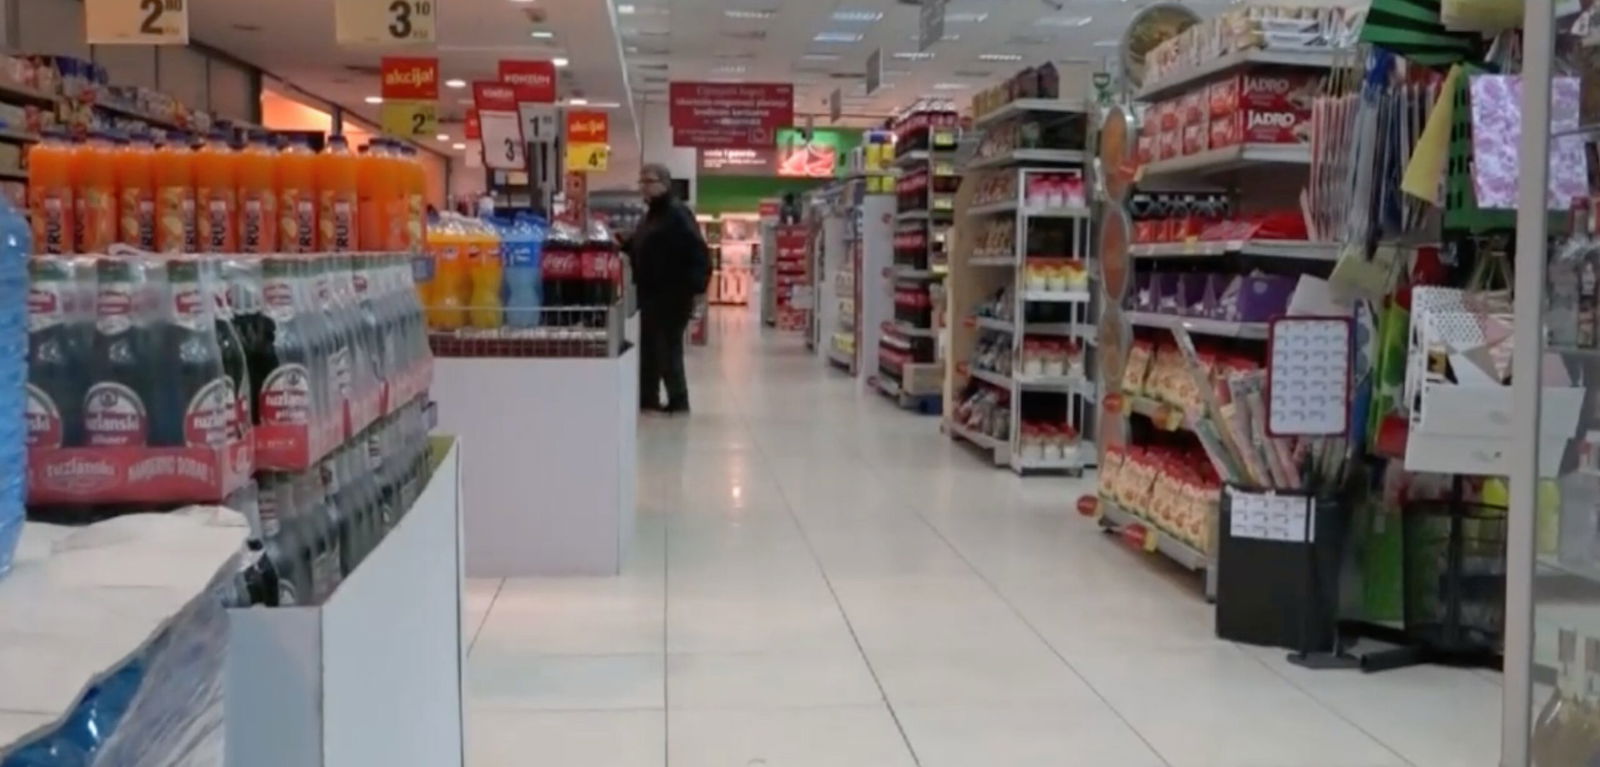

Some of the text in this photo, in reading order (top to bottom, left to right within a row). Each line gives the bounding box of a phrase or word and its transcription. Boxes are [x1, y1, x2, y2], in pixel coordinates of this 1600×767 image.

[139, 0, 163, 35] 2
[388, 0, 431, 39] 3 10
[385, 67, 435, 88] akcija!
[1244, 76, 1289, 95] JADRO
[529, 115, 539, 138] 1
[1248, 110, 1295, 129] JADRO
[504, 137, 515, 162] 3
